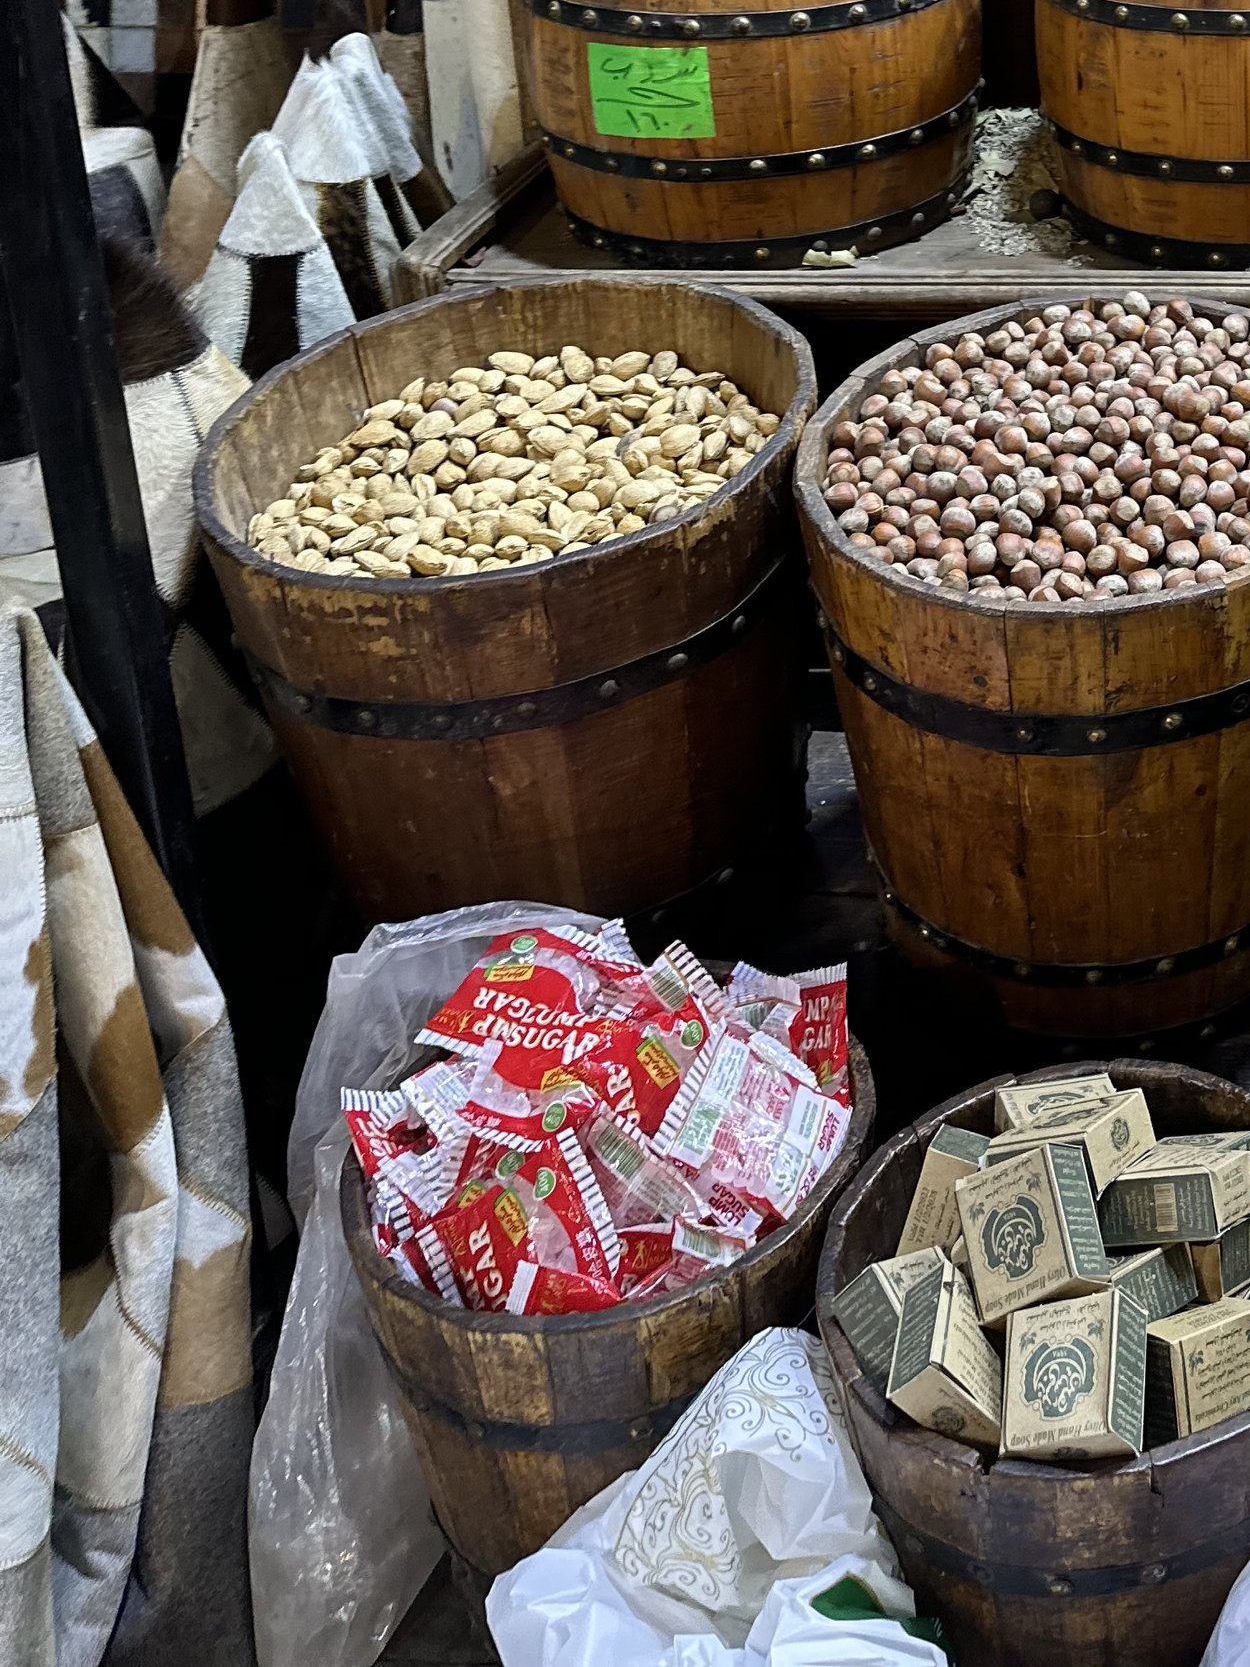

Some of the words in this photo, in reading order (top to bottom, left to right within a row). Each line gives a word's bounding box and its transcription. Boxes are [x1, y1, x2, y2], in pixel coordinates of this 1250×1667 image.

[473, 986, 531, 1020] GAR
[504, 1028, 603, 1066] SUGAR
[801, 1026, 833, 1052] GAR
[817, 1109, 834, 1152] SUGAR
[826, 1116, 841, 1153] LUMP
[708, 1197, 742, 1227] LUMP
[711, 1183, 750, 1218] SUGAR
[1003, 1285, 1025, 1305] Made
[1026, 1274, 1047, 1294] Hand
[984, 1295, 1004, 1314] Soap
[1010, 1433, 1031, 1447] Soap
[1032, 1428, 1056, 1444] Made
[1058, 1424, 1082, 1438] Hand
